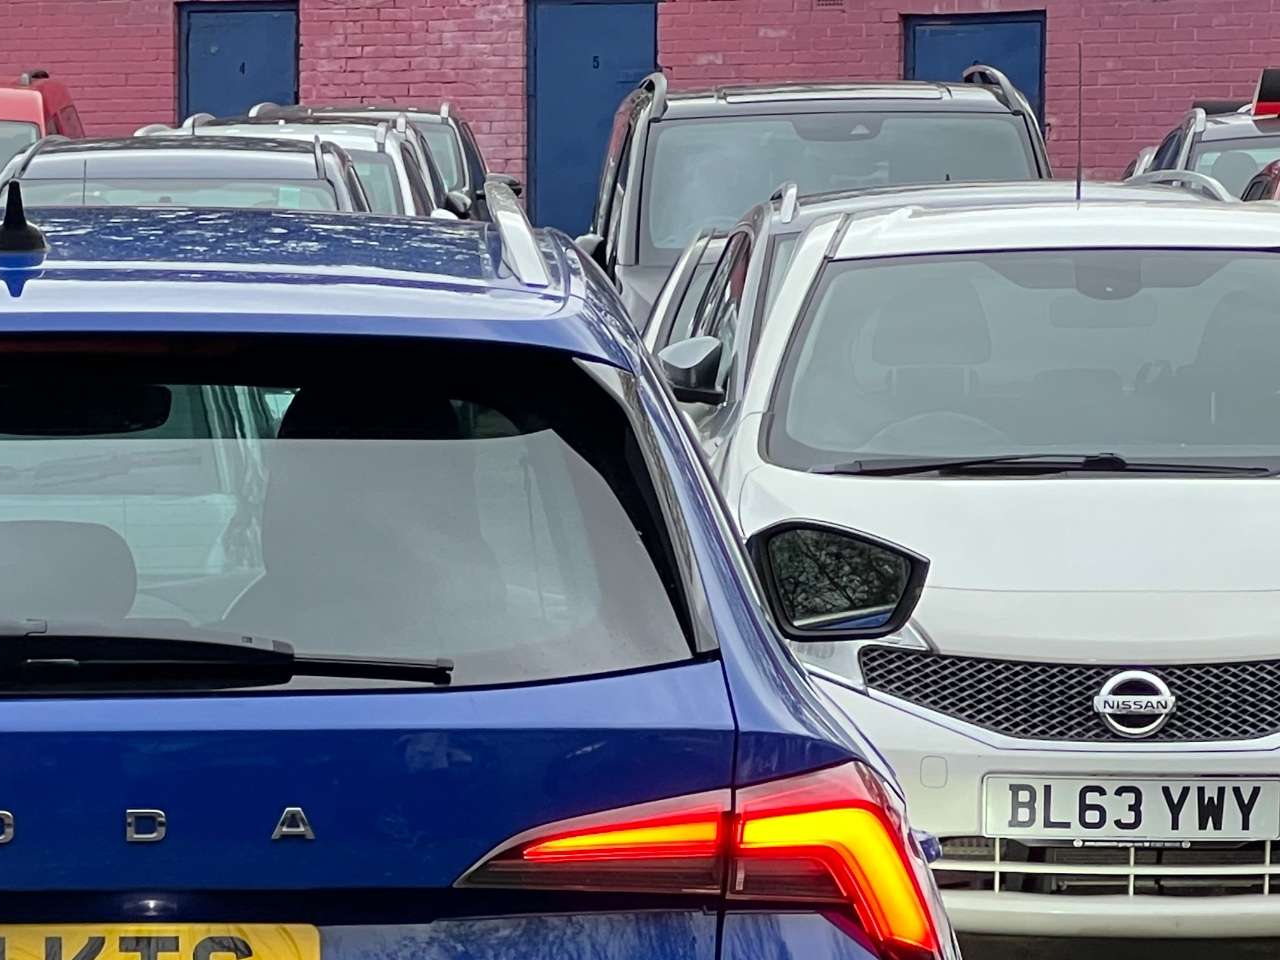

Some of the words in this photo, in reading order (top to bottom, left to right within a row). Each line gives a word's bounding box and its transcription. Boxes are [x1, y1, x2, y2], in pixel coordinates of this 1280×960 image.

[592, 55, 600, 69] 5
[1103, 700, 1168, 710] NISSAN
[1008, 784, 1142, 830] BL63
[1161, 786, 1261, 831] YWY
